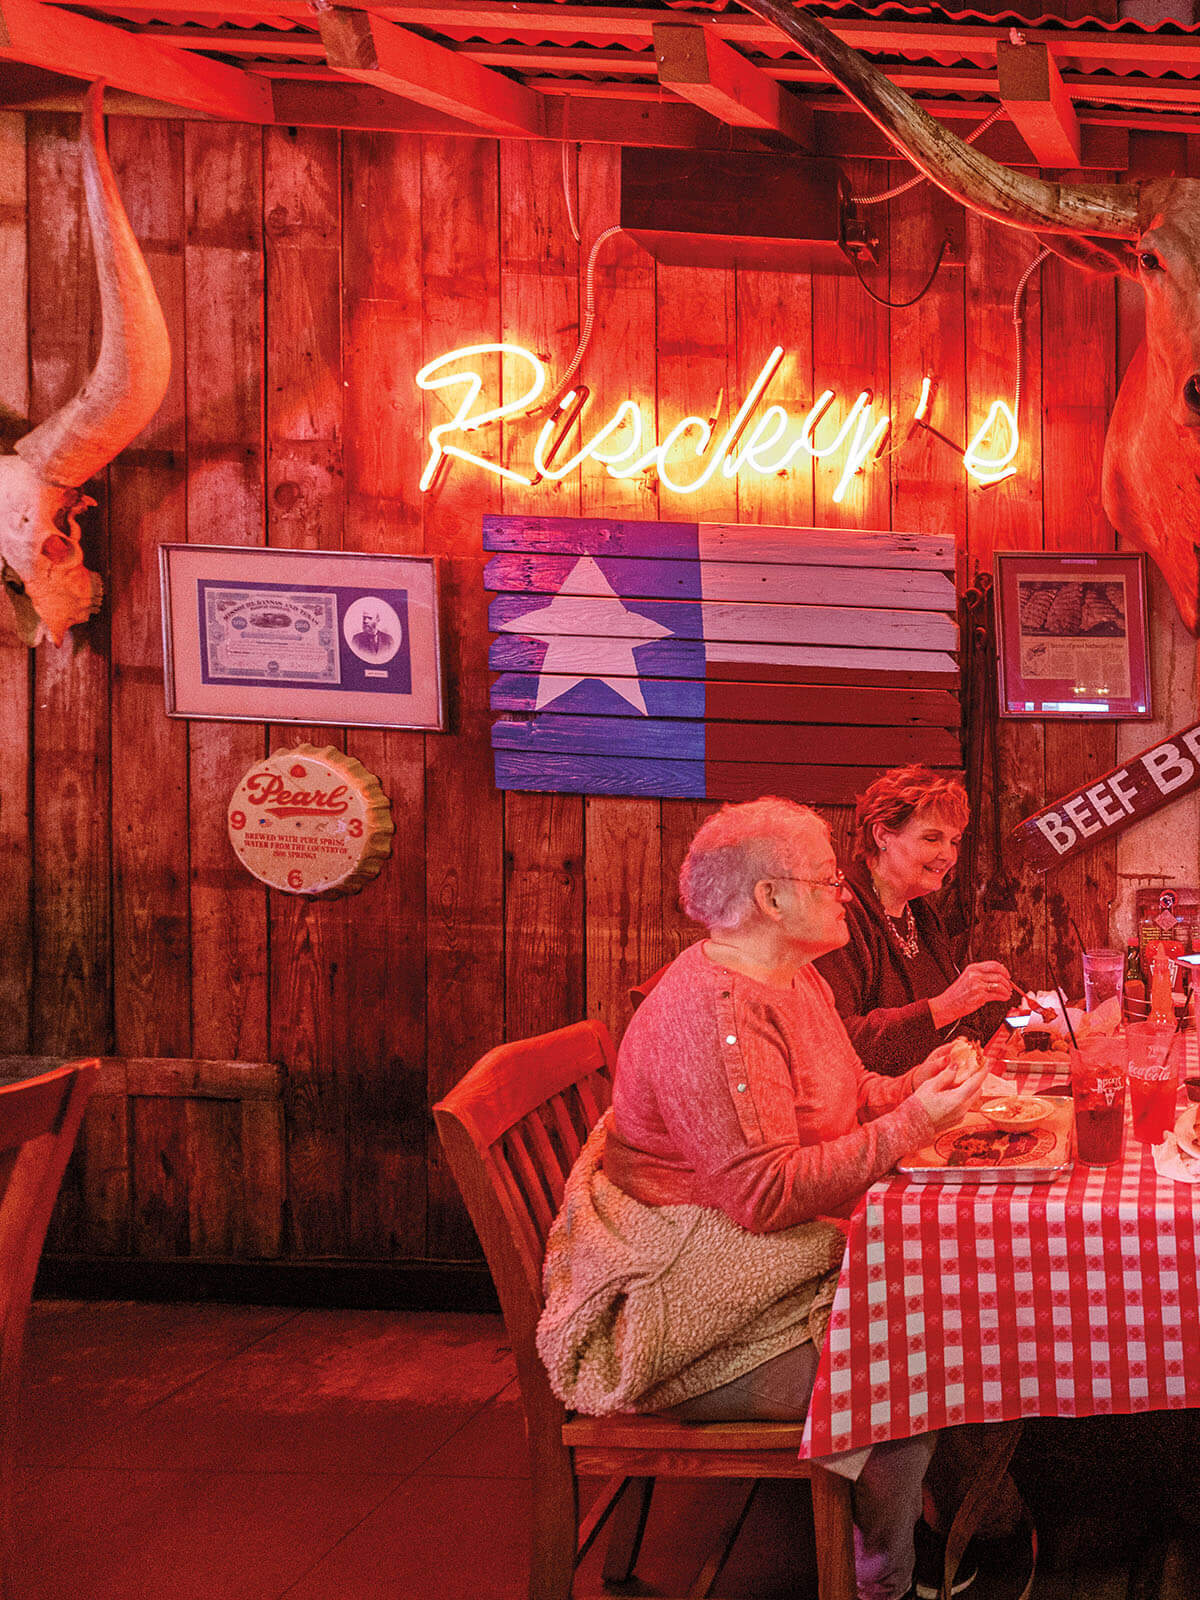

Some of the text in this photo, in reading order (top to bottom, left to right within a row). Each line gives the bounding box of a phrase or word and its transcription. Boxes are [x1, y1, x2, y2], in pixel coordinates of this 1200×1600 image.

[416, 343, 1017, 503] Riscky's
[246, 773, 349, 819] Pearl
[230, 811, 247, 830] 9
[1036, 770, 1139, 855] BEEF
[348, 818, 364, 838] 3
[243, 840, 269, 849] WATER
[270, 842, 290, 850] FROM
[244, 832, 345, 847] BREWED WITH PURE SPRING
[287, 851, 317, 860] SPRINGS
[287, 869, 303, 889] 6
